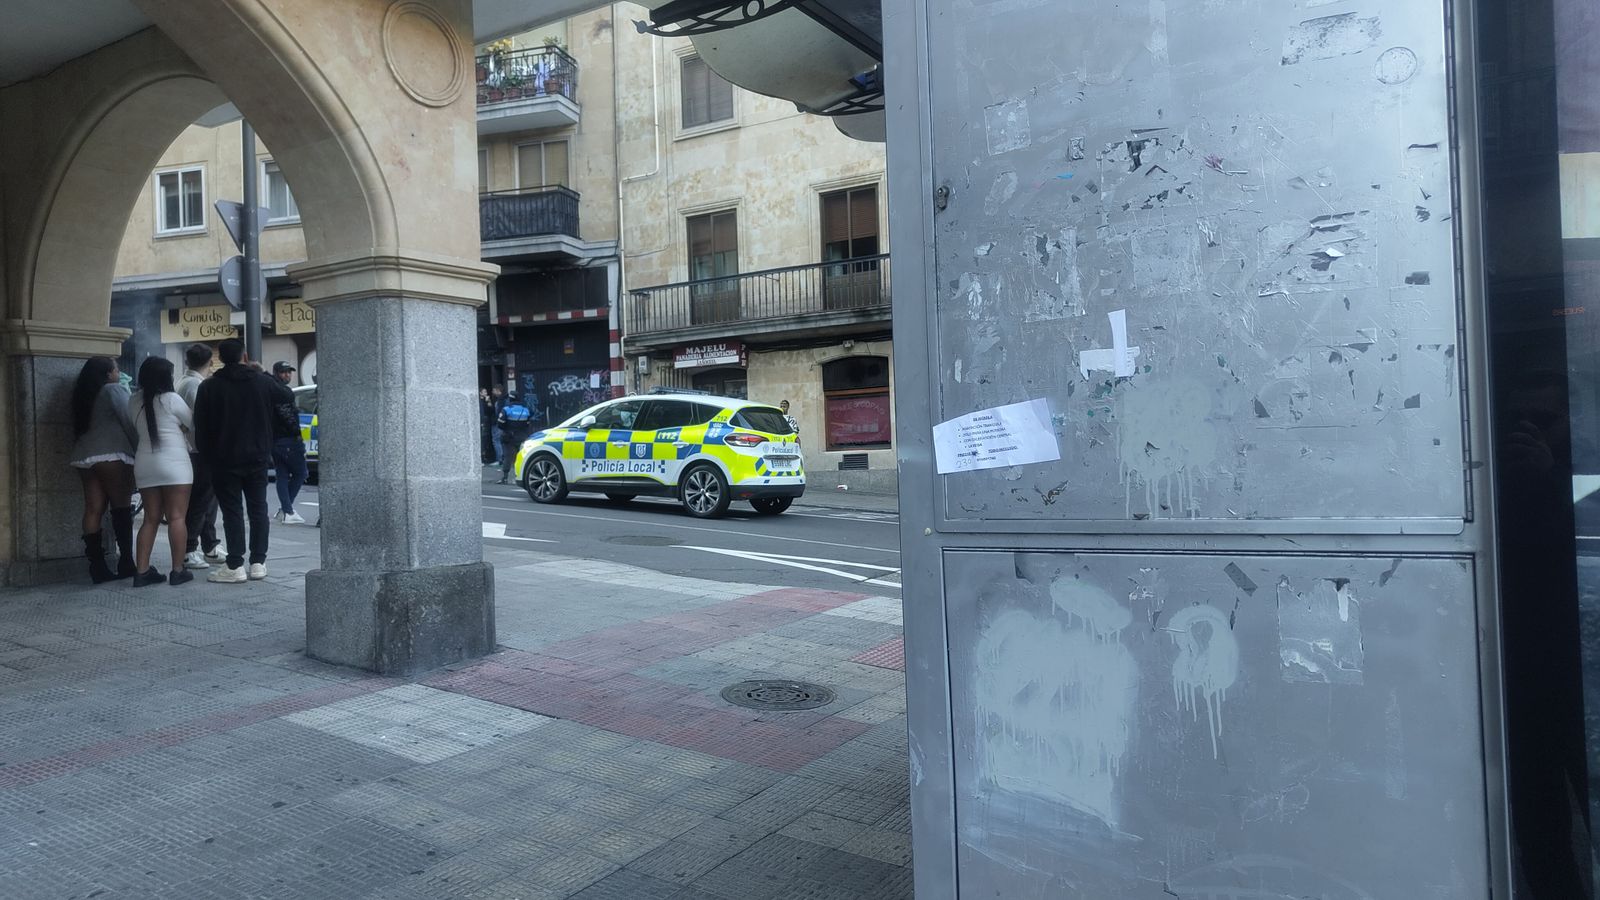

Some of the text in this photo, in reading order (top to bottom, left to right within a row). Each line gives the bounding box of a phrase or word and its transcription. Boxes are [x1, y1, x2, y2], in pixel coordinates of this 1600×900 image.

[183, 310, 223, 323] Comidas
[199, 324, 235, 337] Caseras
[685, 344, 727, 354] MAJELU
[591, 460, 656, 472] Policía Local
